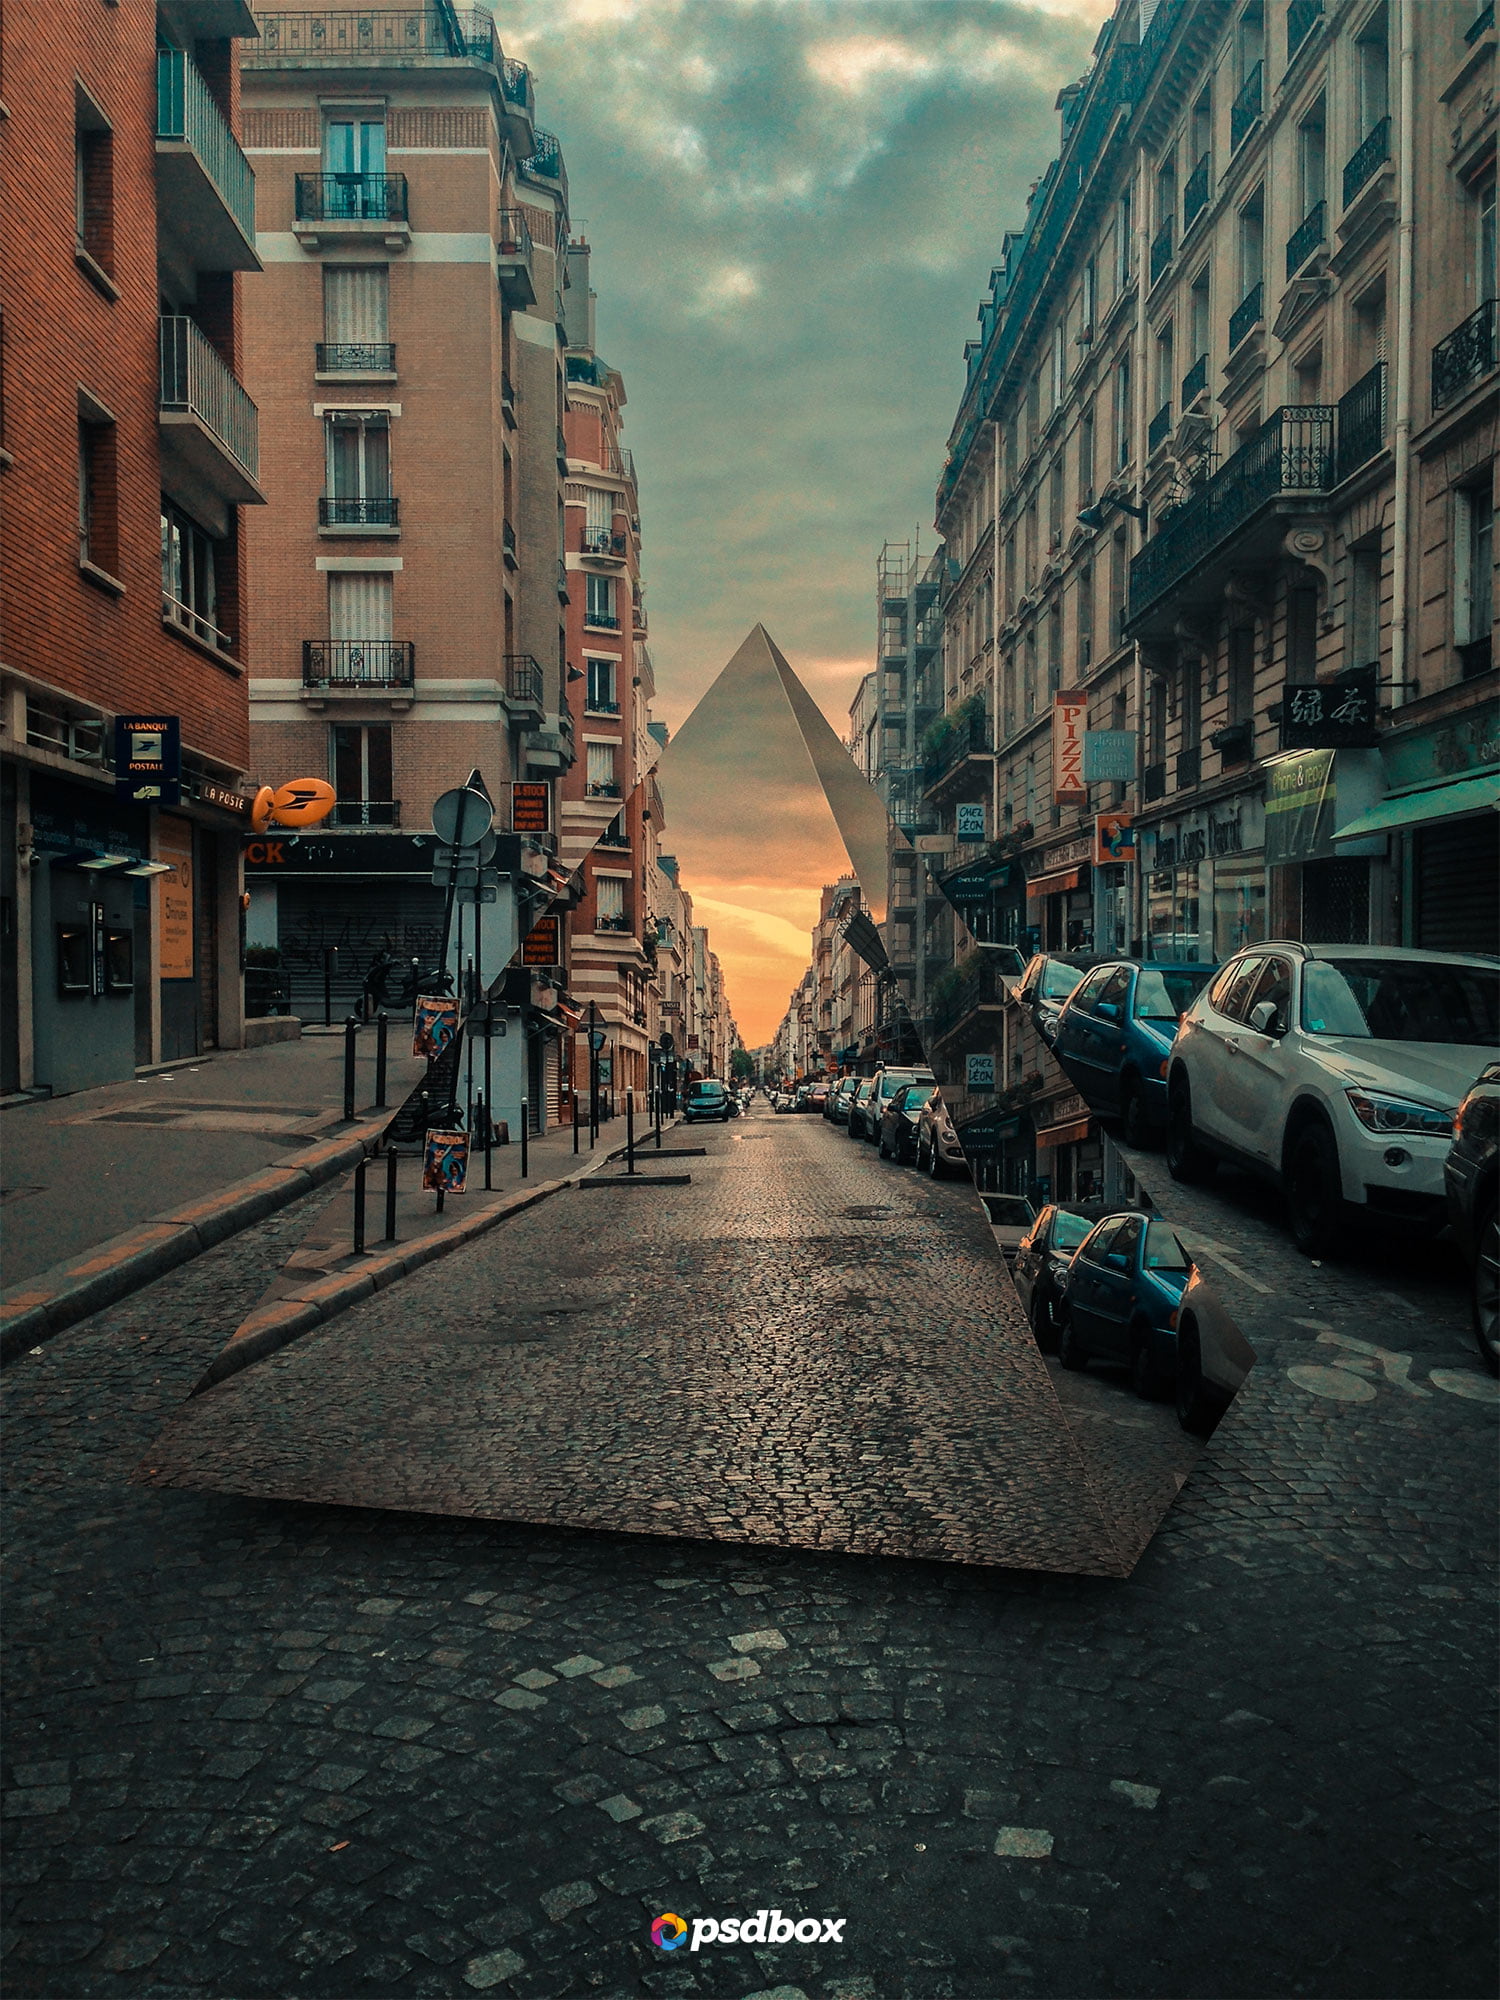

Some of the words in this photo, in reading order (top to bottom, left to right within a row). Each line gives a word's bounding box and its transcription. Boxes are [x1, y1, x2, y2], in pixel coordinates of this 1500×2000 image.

[123, 722, 134, 731] LA
[135, 722, 169, 732] BANQUE
[1094, 732, 1126, 748] Jean
[1060, 707, 1083, 789] PIZZA
[129, 763, 164, 772] POSTALE
[1297, 764, 1305, 787] &
[204, 786, 216, 801] LA
[218, 791, 246, 811] POSTE
[959, 806, 984, 817] CHEZ
[958, 818, 984, 831] LÉON
[244, 842, 286, 864] CK
[969, 1057, 993, 1068] CHEZ
[968, 1069, 994, 1082] LÉON
